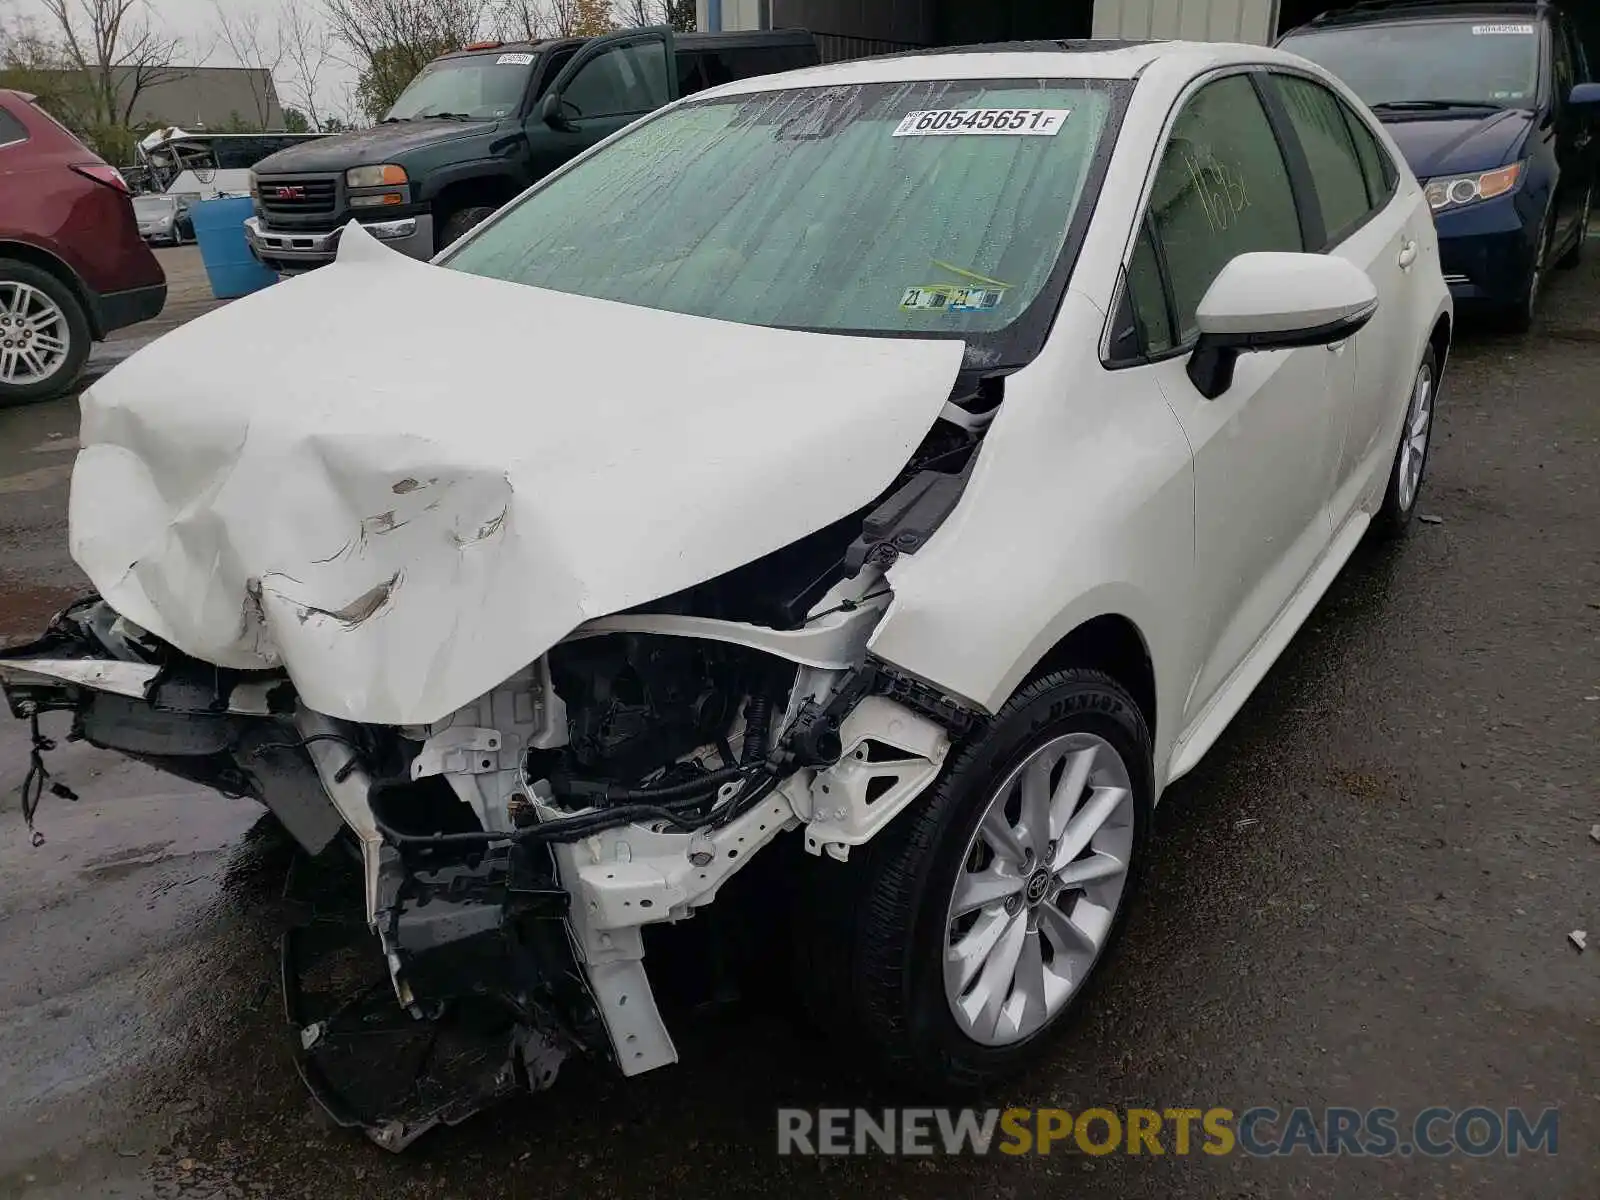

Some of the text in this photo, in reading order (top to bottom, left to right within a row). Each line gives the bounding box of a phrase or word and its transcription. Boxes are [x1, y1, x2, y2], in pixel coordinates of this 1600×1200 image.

[915, 110, 1044, 130] 60545651
[1042, 116, 1056, 128] F
[904, 289, 921, 306] 21
[952, 289, 970, 306] 21
